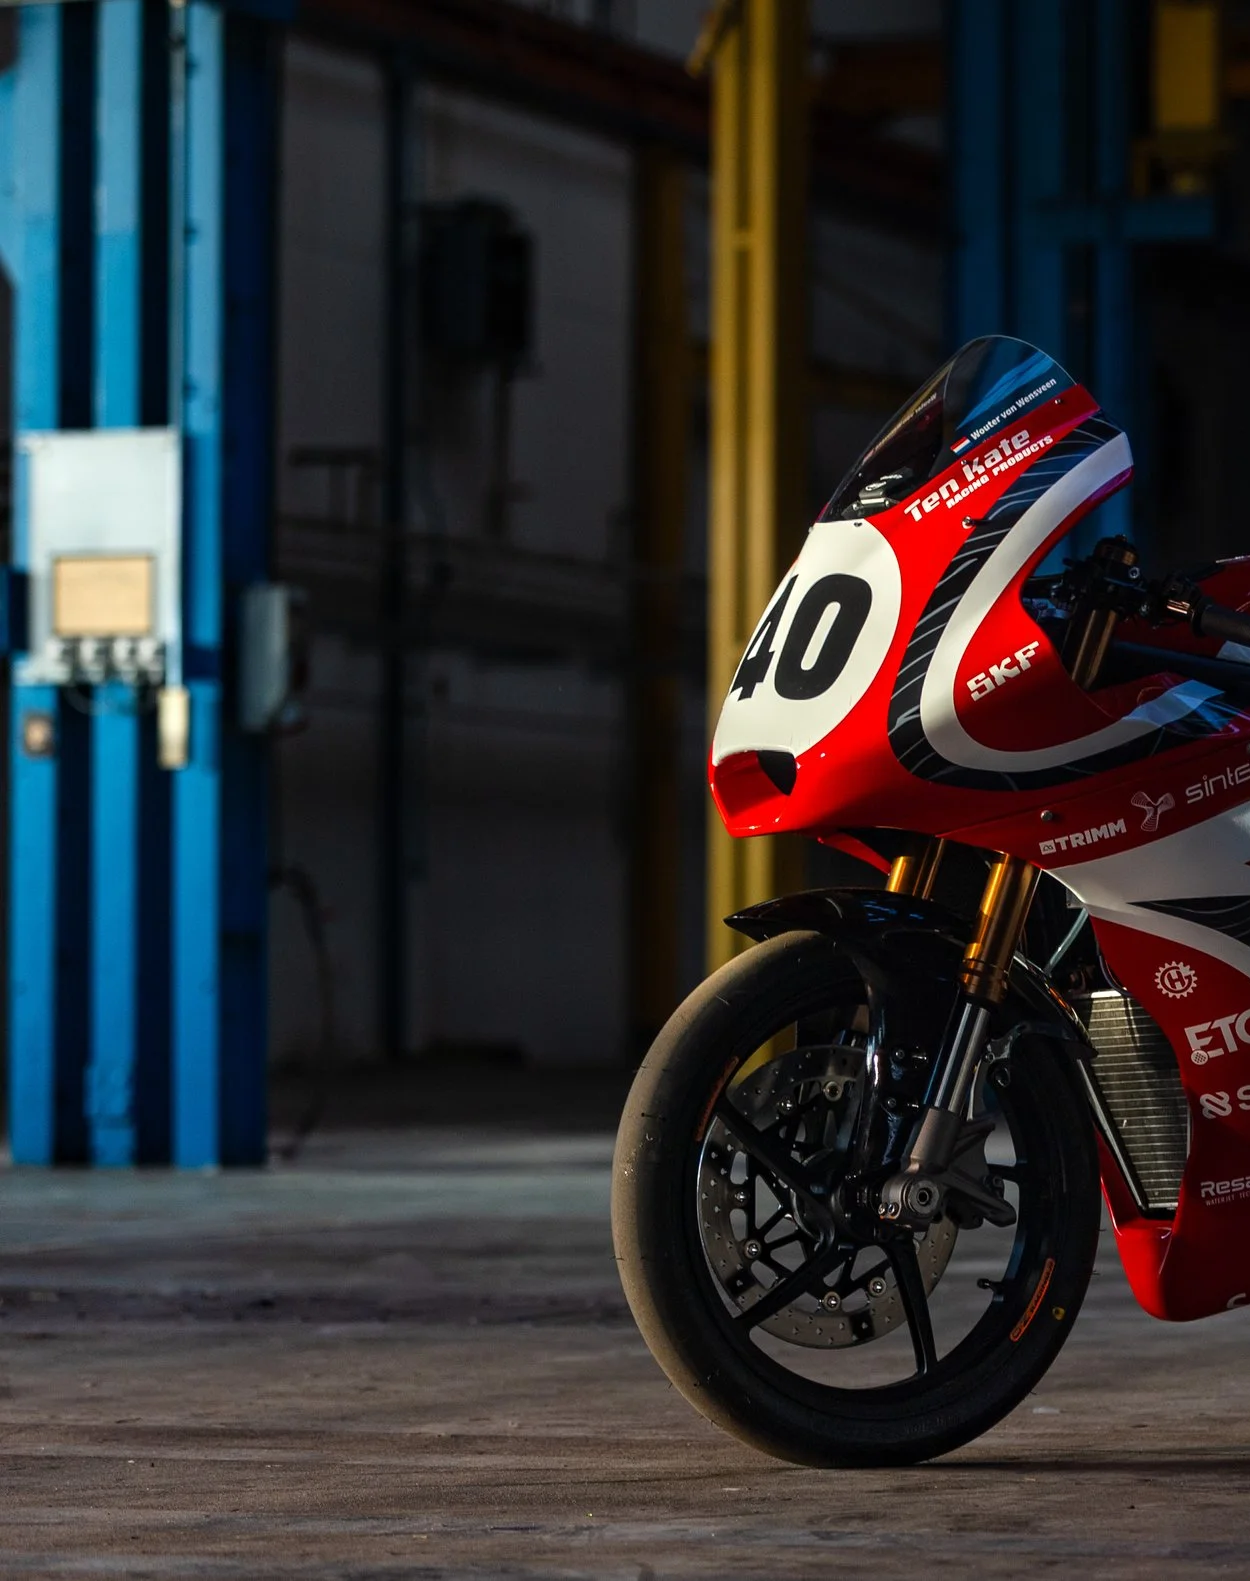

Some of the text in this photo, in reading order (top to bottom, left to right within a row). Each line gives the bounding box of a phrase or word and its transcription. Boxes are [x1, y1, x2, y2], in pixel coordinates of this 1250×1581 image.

[970, 378, 1057, 440] Wouter van Wensveen
[904, 429, 1030, 522] Ten Kate
[946, 435, 1054, 509] RACING PRODUCTS
[730, 573, 872, 701] 40
[966, 641, 1040, 702] SKF
[1055, 817, 1127, 852] TRIMM
